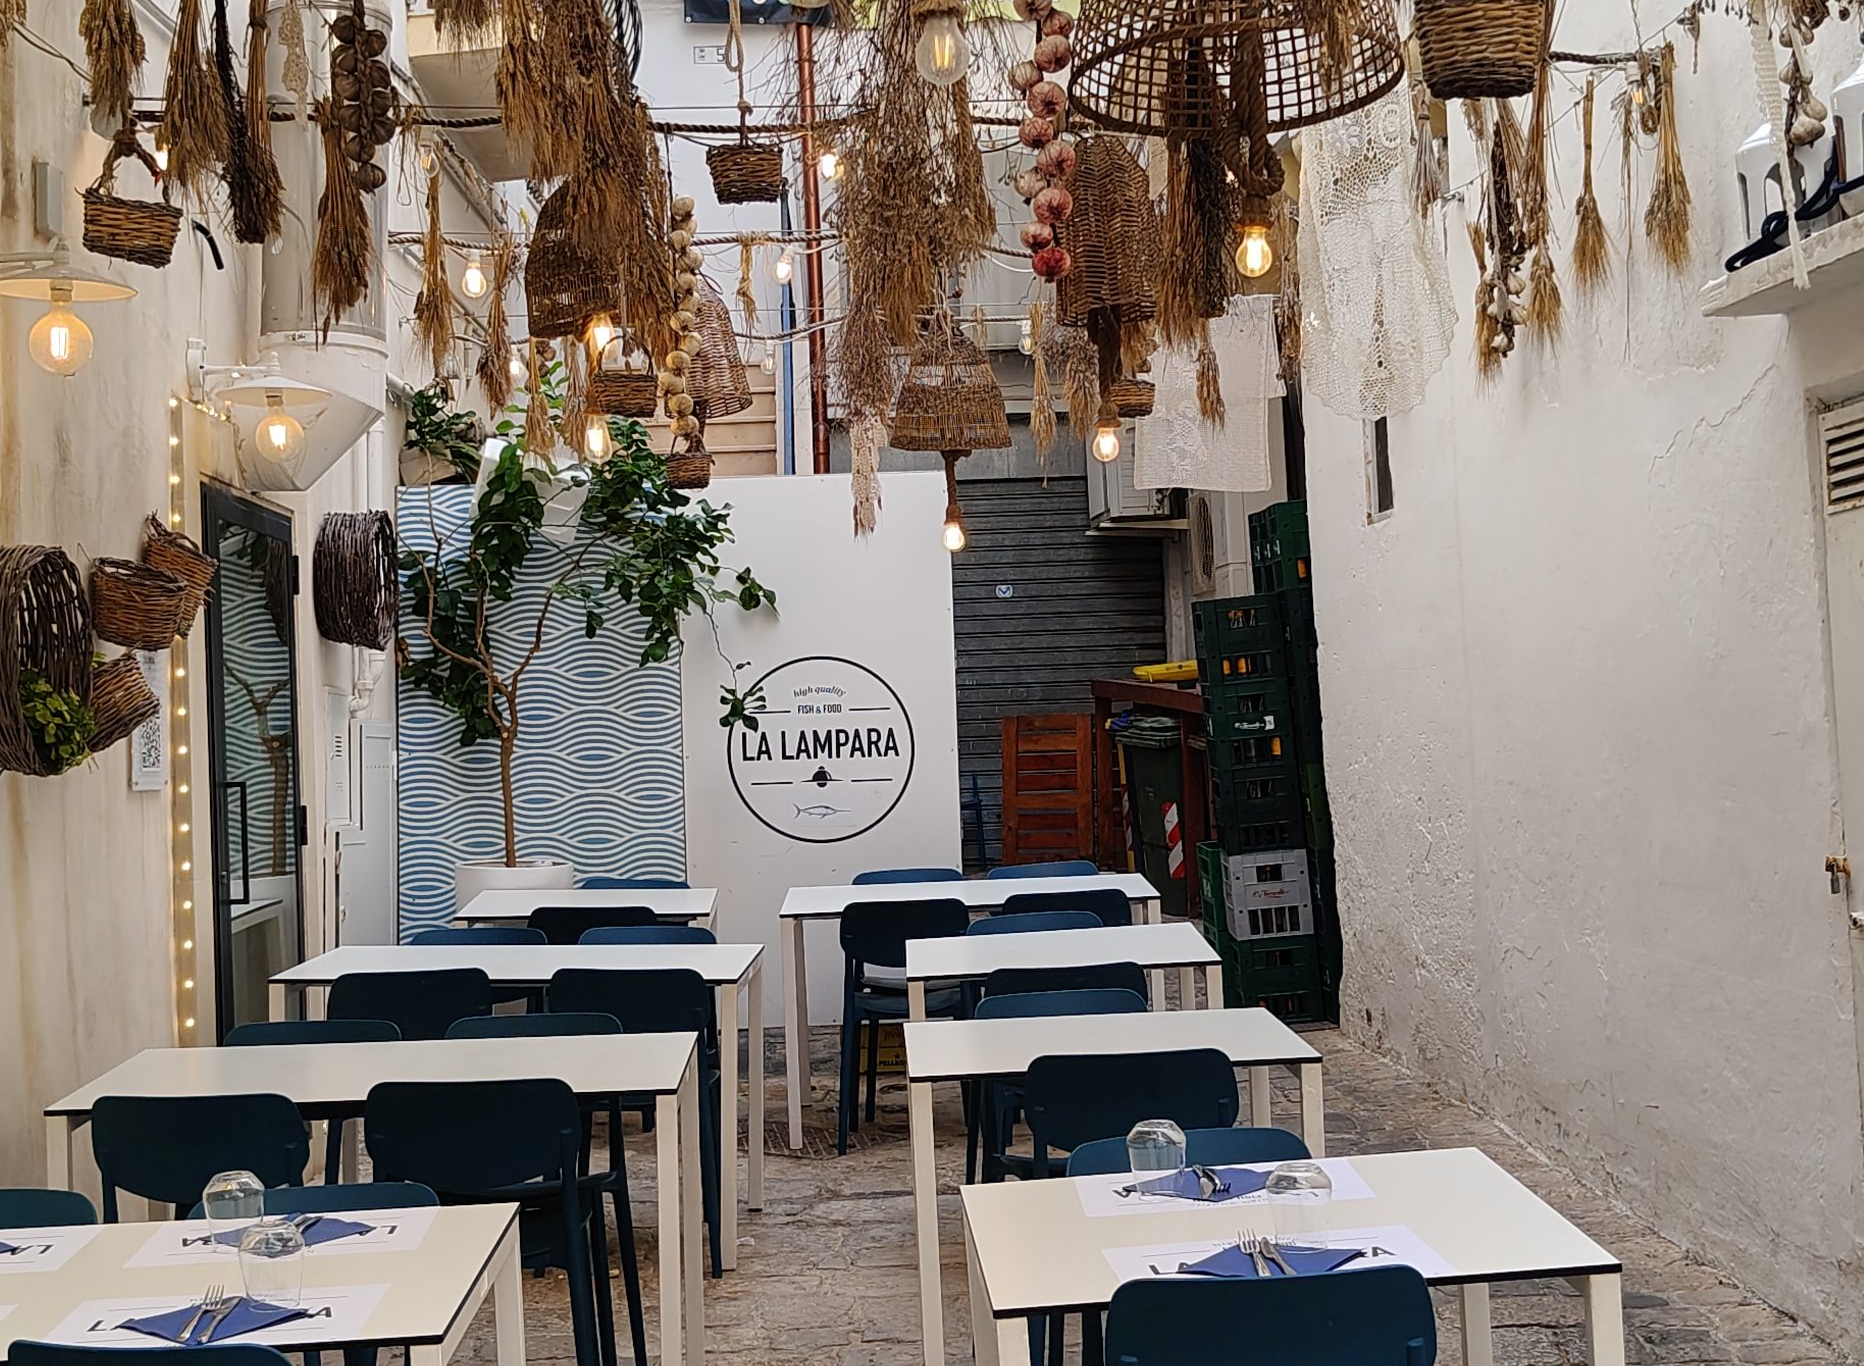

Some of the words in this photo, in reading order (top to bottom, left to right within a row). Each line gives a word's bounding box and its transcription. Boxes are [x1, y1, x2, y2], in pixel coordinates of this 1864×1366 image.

[793, 686, 813, 699] high
[814, 685, 847, 698] quality
[797, 705, 814, 715] FISH
[815, 706, 822, 715] &
[823, 704, 842, 714] FOOD
[741, 732, 772, 761] LA
[781, 727, 900, 760] LAMPARA
